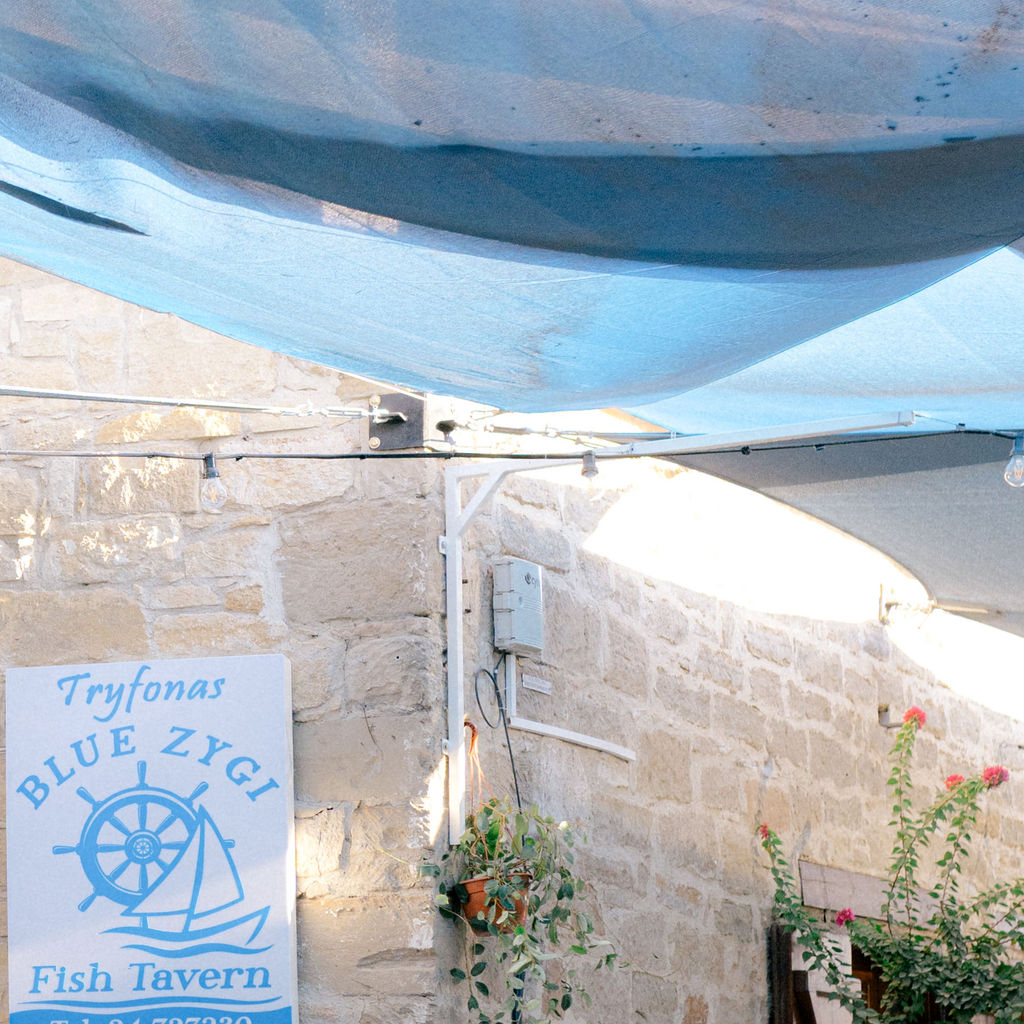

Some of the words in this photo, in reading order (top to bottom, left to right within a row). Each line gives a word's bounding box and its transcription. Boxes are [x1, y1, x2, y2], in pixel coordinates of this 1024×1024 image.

[56, 664, 226, 723] Tryfonas
[15, 724, 137, 811] BLUE
[160, 725, 281, 803] ZYGI
[28, 962, 114, 995] Fish
[129, 961, 273, 993] Tavern
